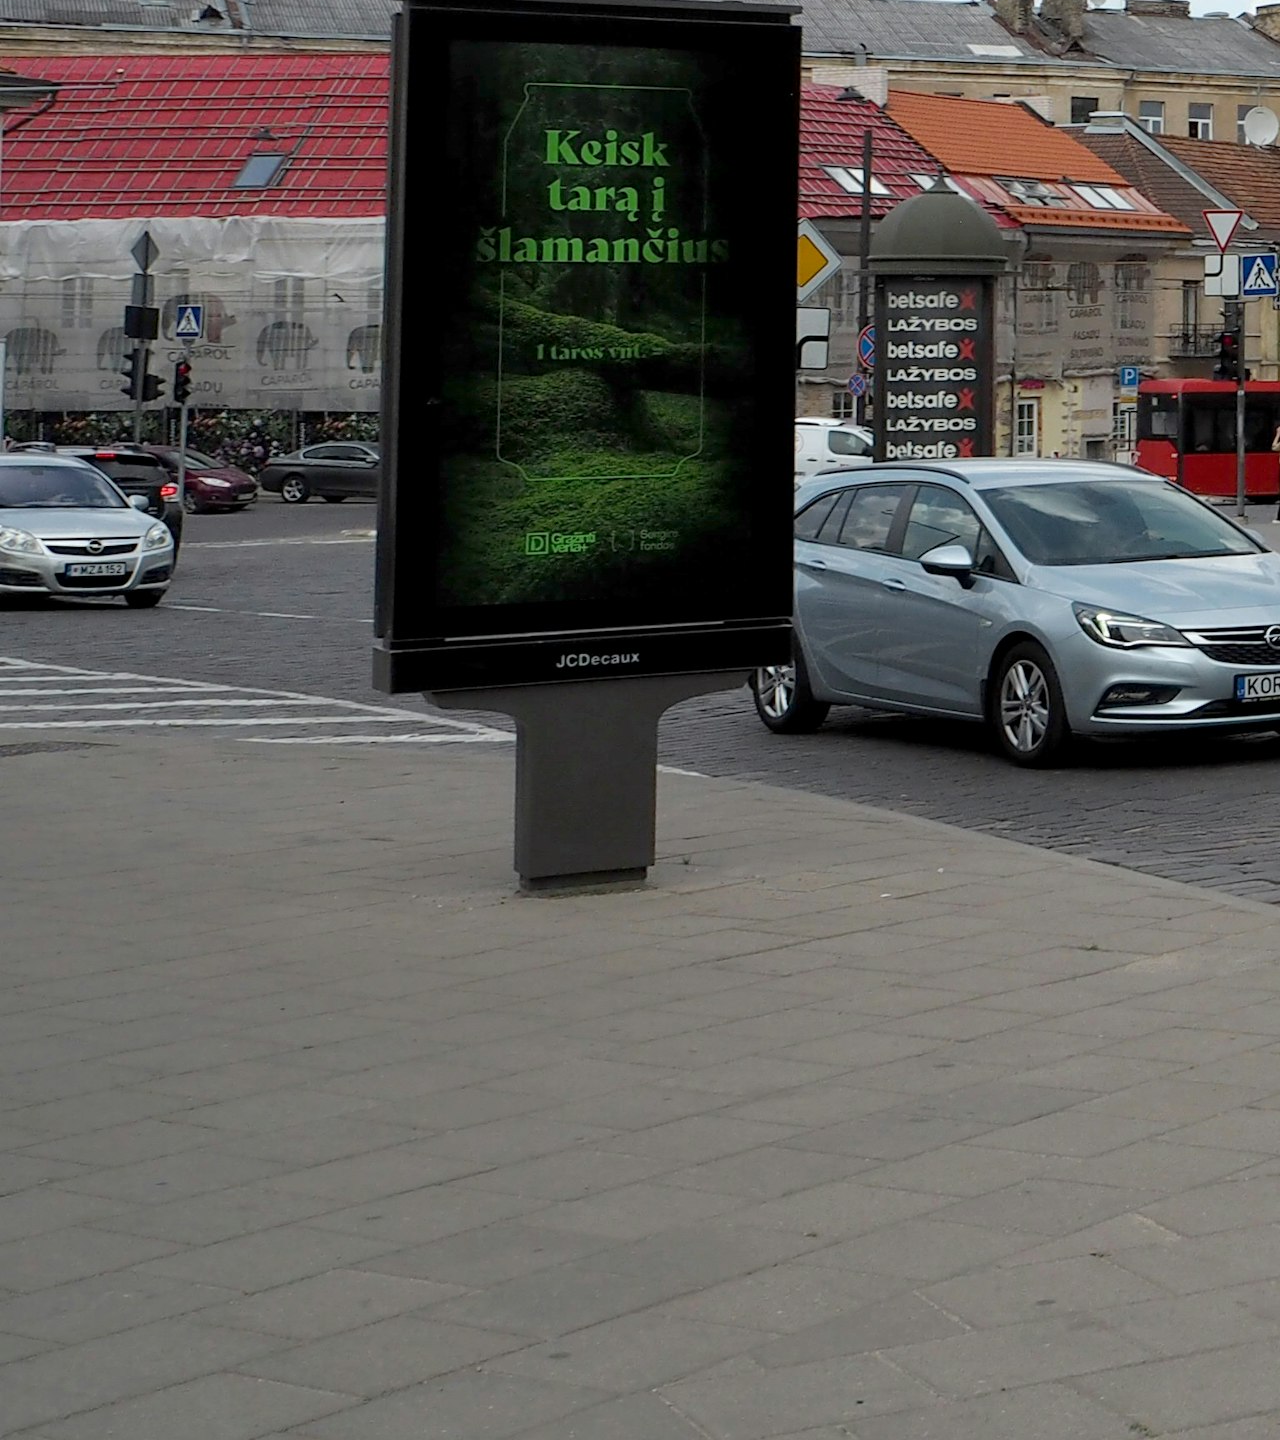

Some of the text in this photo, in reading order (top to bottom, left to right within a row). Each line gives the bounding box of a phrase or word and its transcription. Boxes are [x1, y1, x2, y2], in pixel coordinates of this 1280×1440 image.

[544, 129, 670, 167] Keisk
[547, 176, 666, 222] tarą į
[476, 225, 729, 264] šlamančius
[887, 291, 959, 309] betsafe
[887, 316, 978, 332] LAŽYBOS
[167, 348, 232, 363] CAPAROL
[550, 345, 605, 360] taros
[887, 341, 959, 359] betsafe
[887, 366, 977, 382] LAŽYBOS
[1124, 369, 1135, 385] P
[349, 378, 381, 390] CAPA
[887, 391, 958, 409] betsafe
[886, 416, 977, 432] LAŽYBOS
[886, 441, 957, 459] betsafe
[555, 652, 640, 668] JCDecaux
